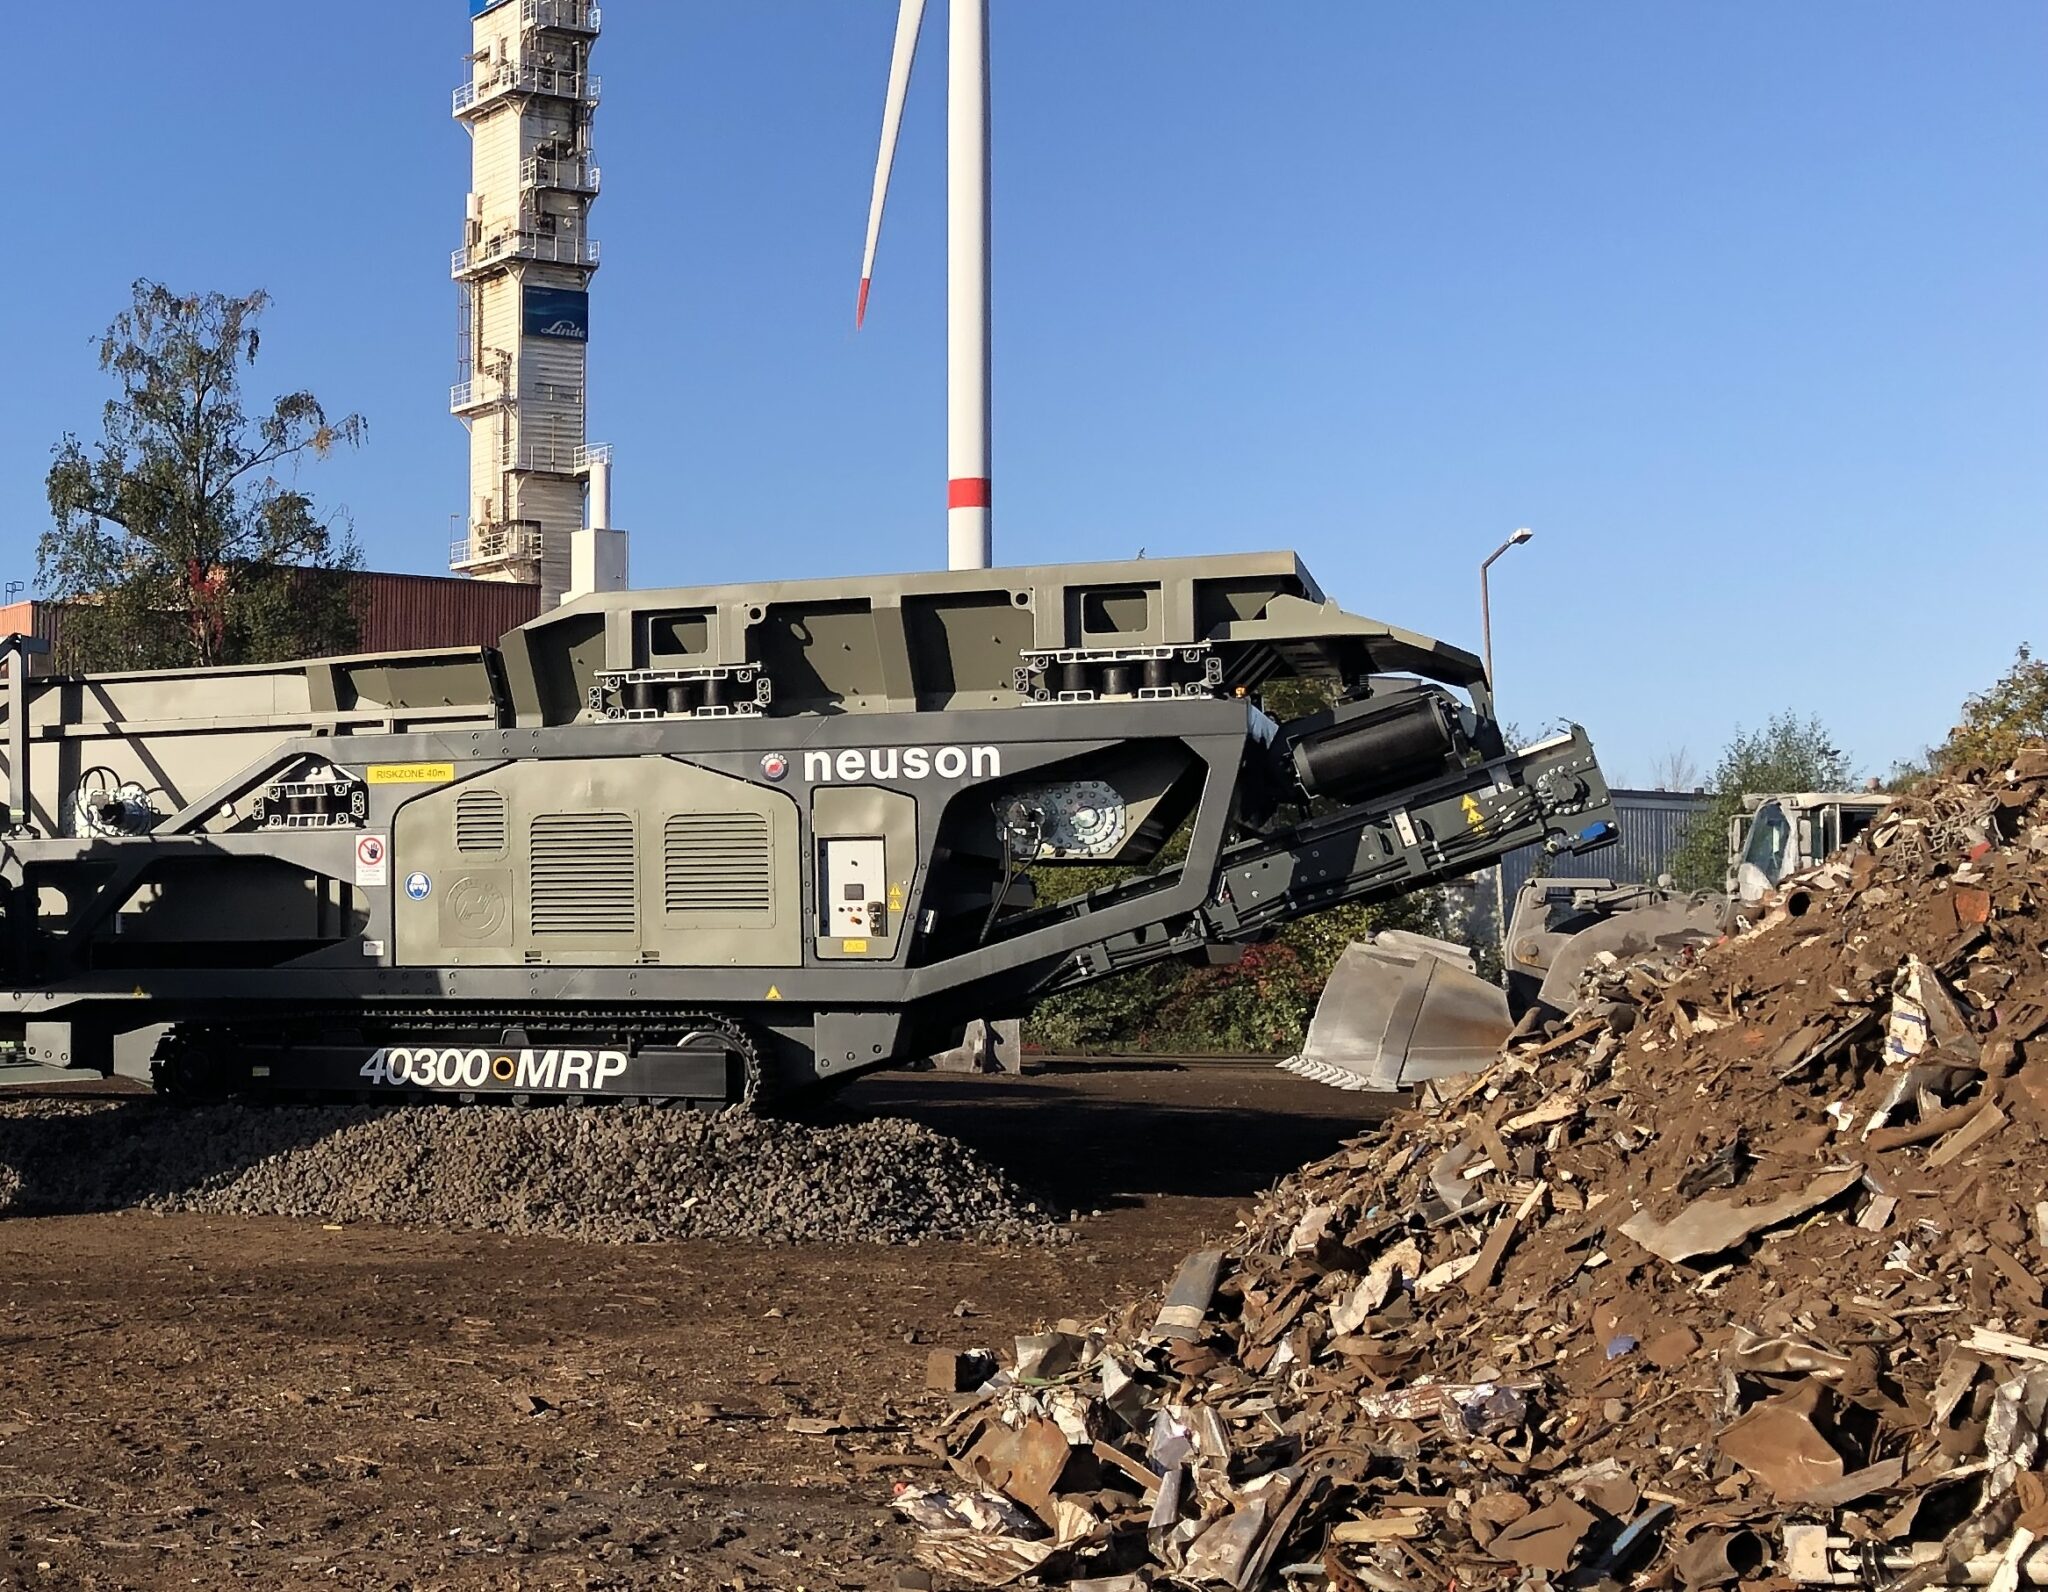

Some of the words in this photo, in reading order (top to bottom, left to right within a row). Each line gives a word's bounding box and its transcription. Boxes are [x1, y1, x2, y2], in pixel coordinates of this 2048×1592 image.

[540, 320, 586, 338] Linde
[376, 769, 425, 779] RISKZONE
[426, 768, 446, 777] 40m
[803, 746, 1001, 782] neuson
[360, 1048, 490, 1087] 40300
[514, 1049, 628, 1089] MRP
